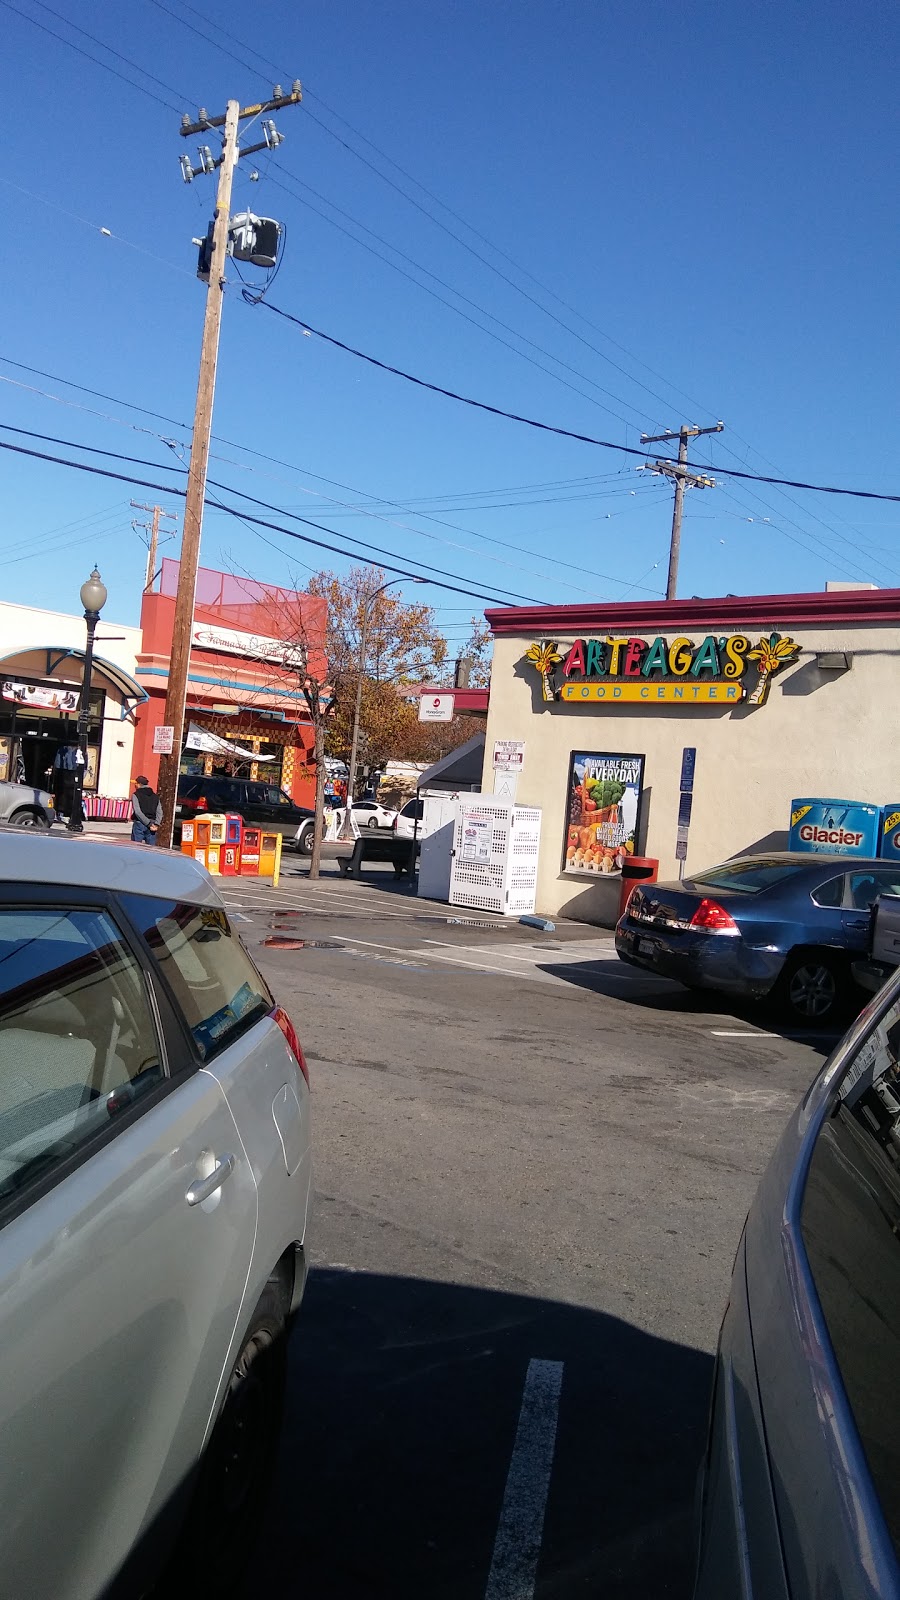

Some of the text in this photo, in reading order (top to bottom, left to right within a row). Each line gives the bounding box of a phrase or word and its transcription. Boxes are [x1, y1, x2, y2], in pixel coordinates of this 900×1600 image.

[562, 635, 748, 678] ARTEAGA'S
[566, 686, 737, 699] FOOD CENTER
[590, 759, 640, 770] AVAILABLE FRESH
[589, 767, 639, 783] EVERYDAY
[800, 825, 864, 846] Glacier
